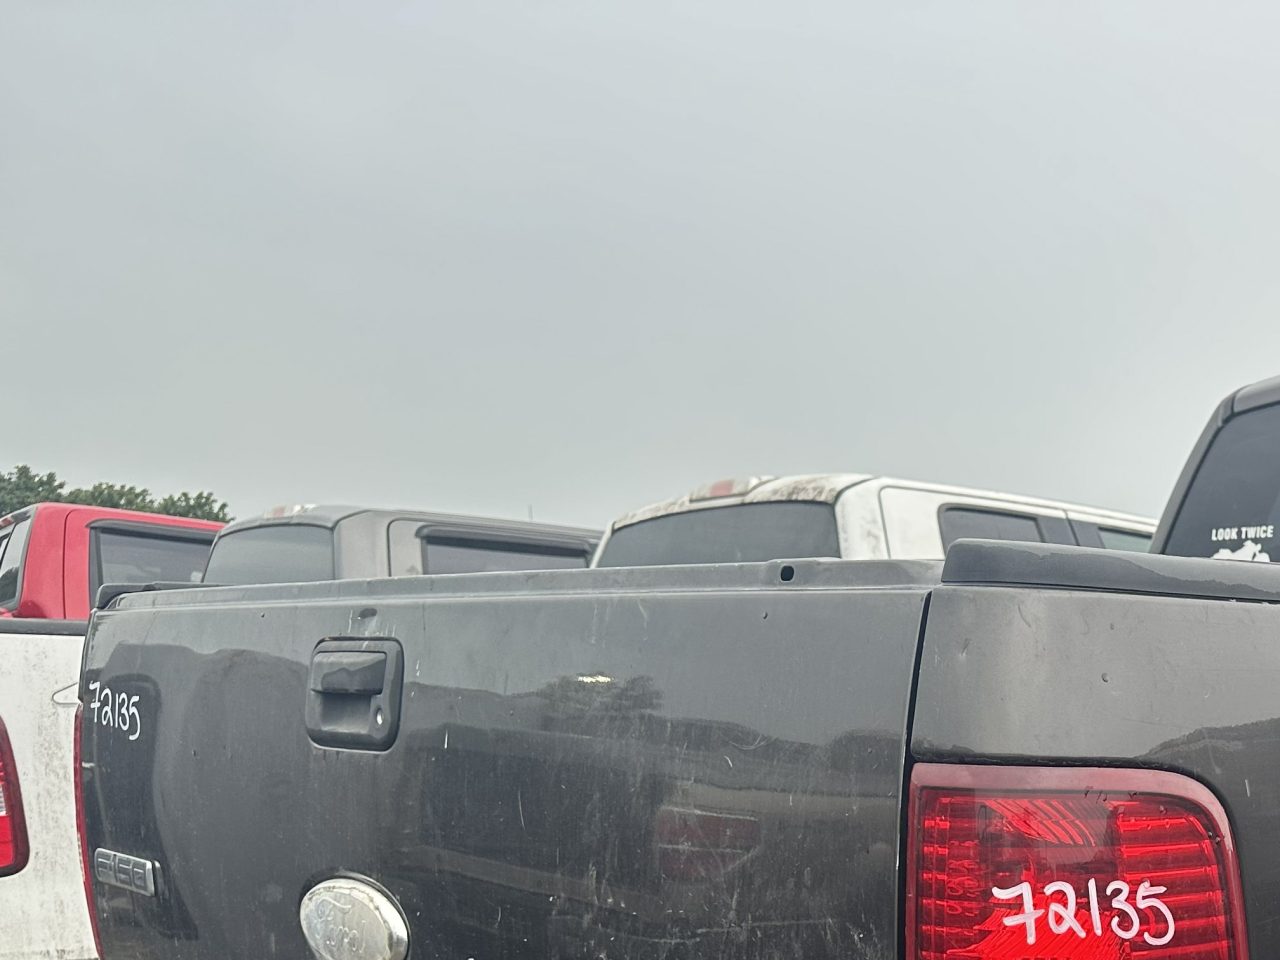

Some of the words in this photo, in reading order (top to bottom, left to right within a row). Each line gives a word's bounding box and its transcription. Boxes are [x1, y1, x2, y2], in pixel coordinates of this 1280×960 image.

[1211, 527, 1239, 541] LOOK
[1240, 525, 1274, 539] TWICE
[89, 680, 140, 741] 72135
[991, 877, 1176, 946] 72135
